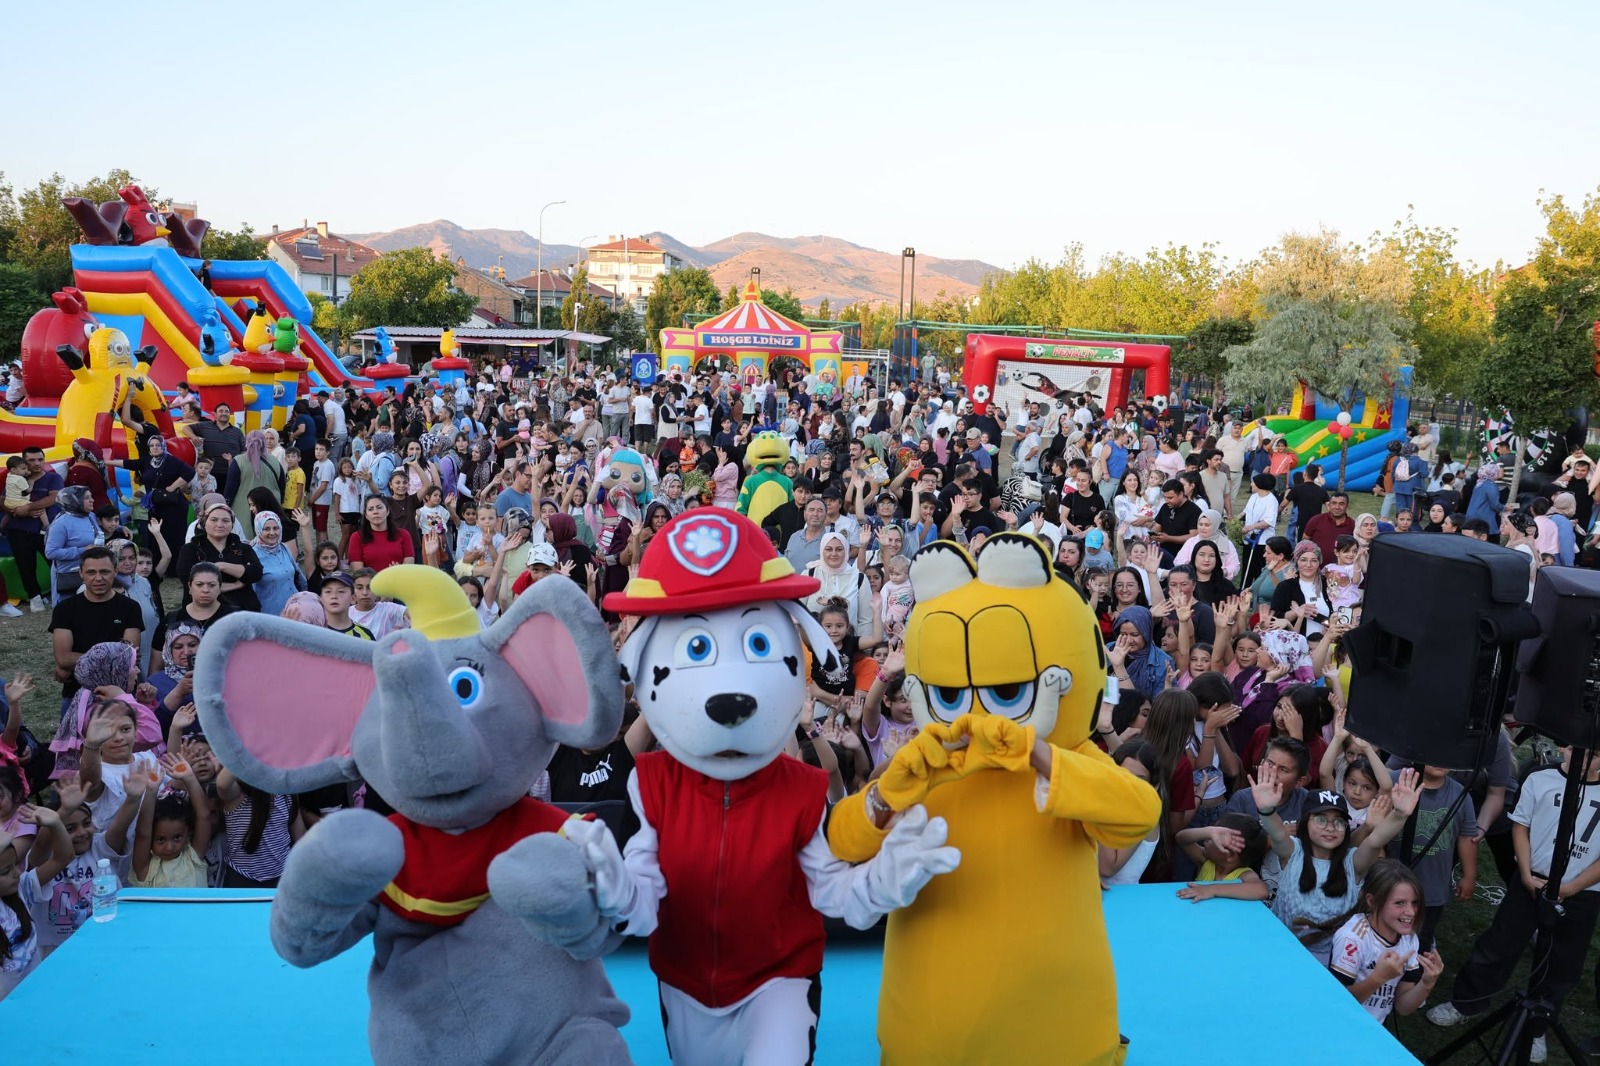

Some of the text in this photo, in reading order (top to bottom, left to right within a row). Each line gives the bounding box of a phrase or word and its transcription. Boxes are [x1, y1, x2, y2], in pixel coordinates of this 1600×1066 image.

[1544, 441, 1555, 454] 14
[1537, 453, 1548, 466] 19
[579, 768, 609, 787] PUMA
[1319, 790, 1340, 805] NY
